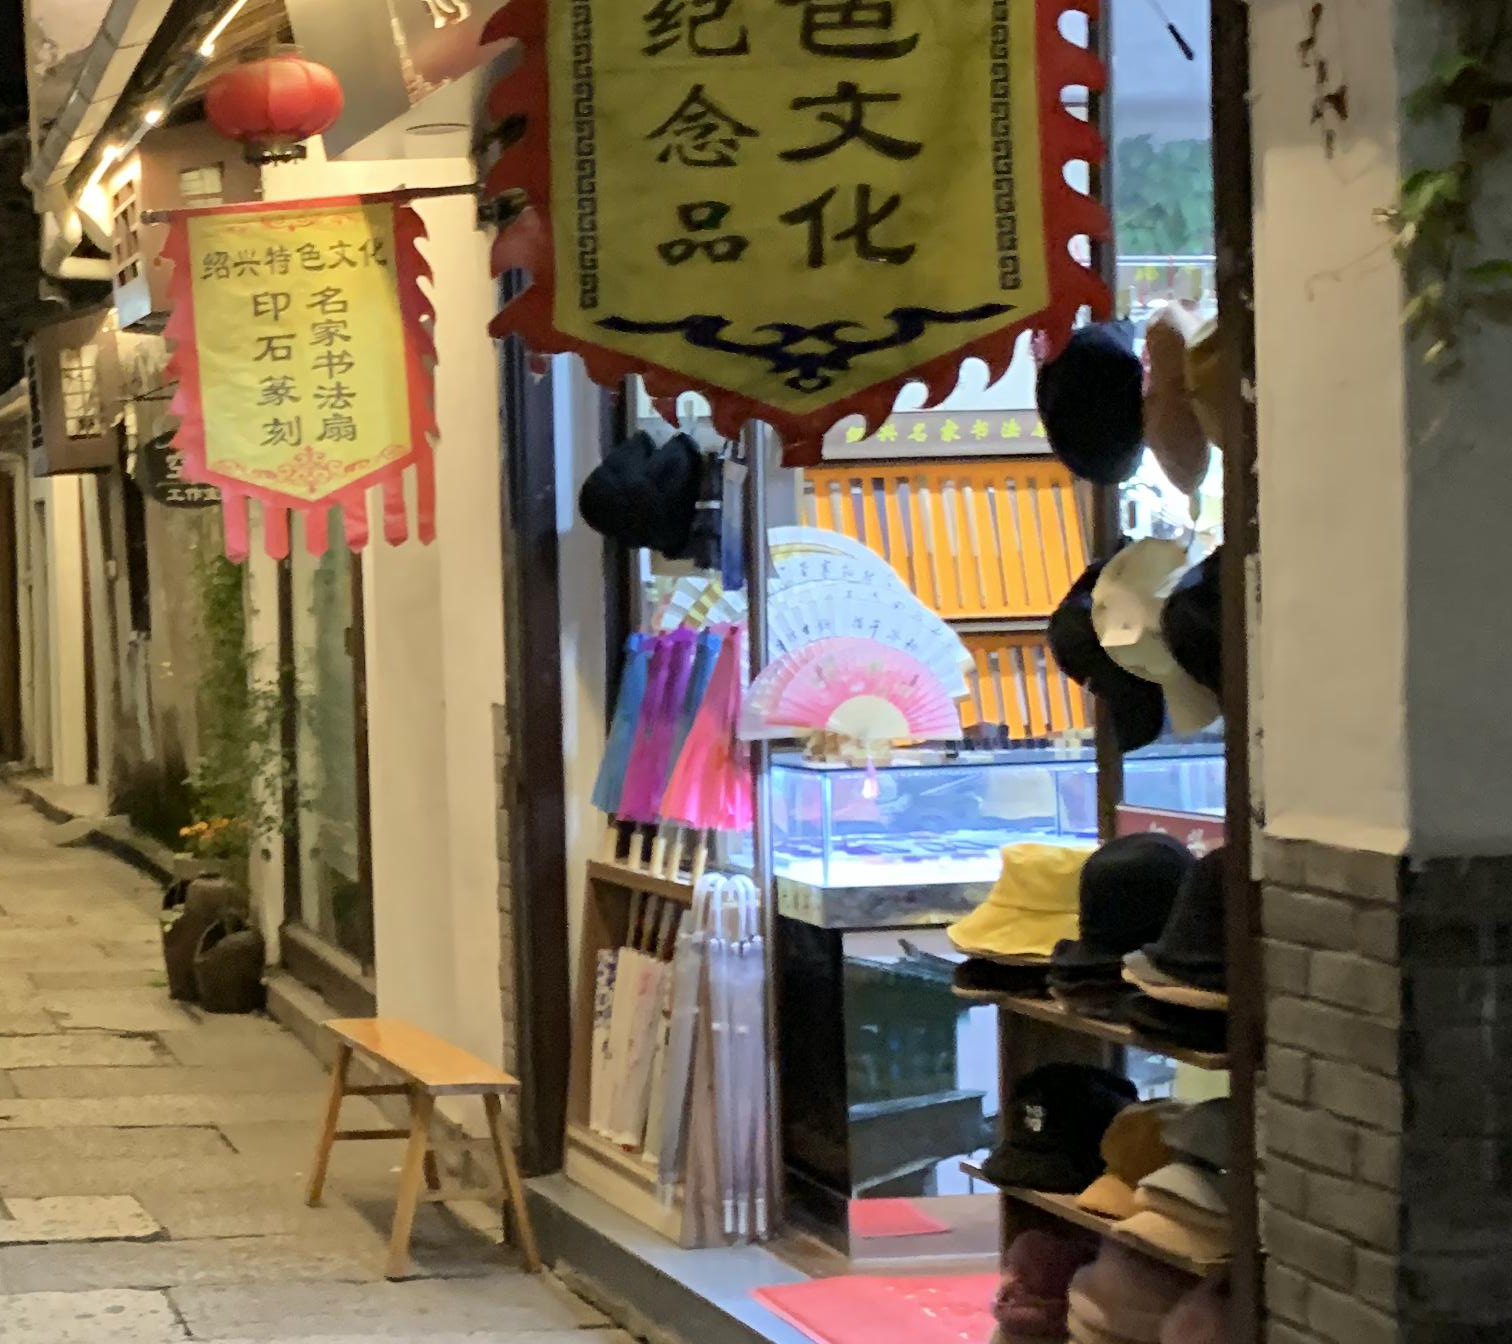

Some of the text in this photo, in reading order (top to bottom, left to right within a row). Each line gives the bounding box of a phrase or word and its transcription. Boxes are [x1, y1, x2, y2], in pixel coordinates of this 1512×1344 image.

[200, 240, 389, 280] 绍兴特色文化
[252, 291, 303, 447] 印石篆刻
[306, 287, 358, 442] 名家书法扇
